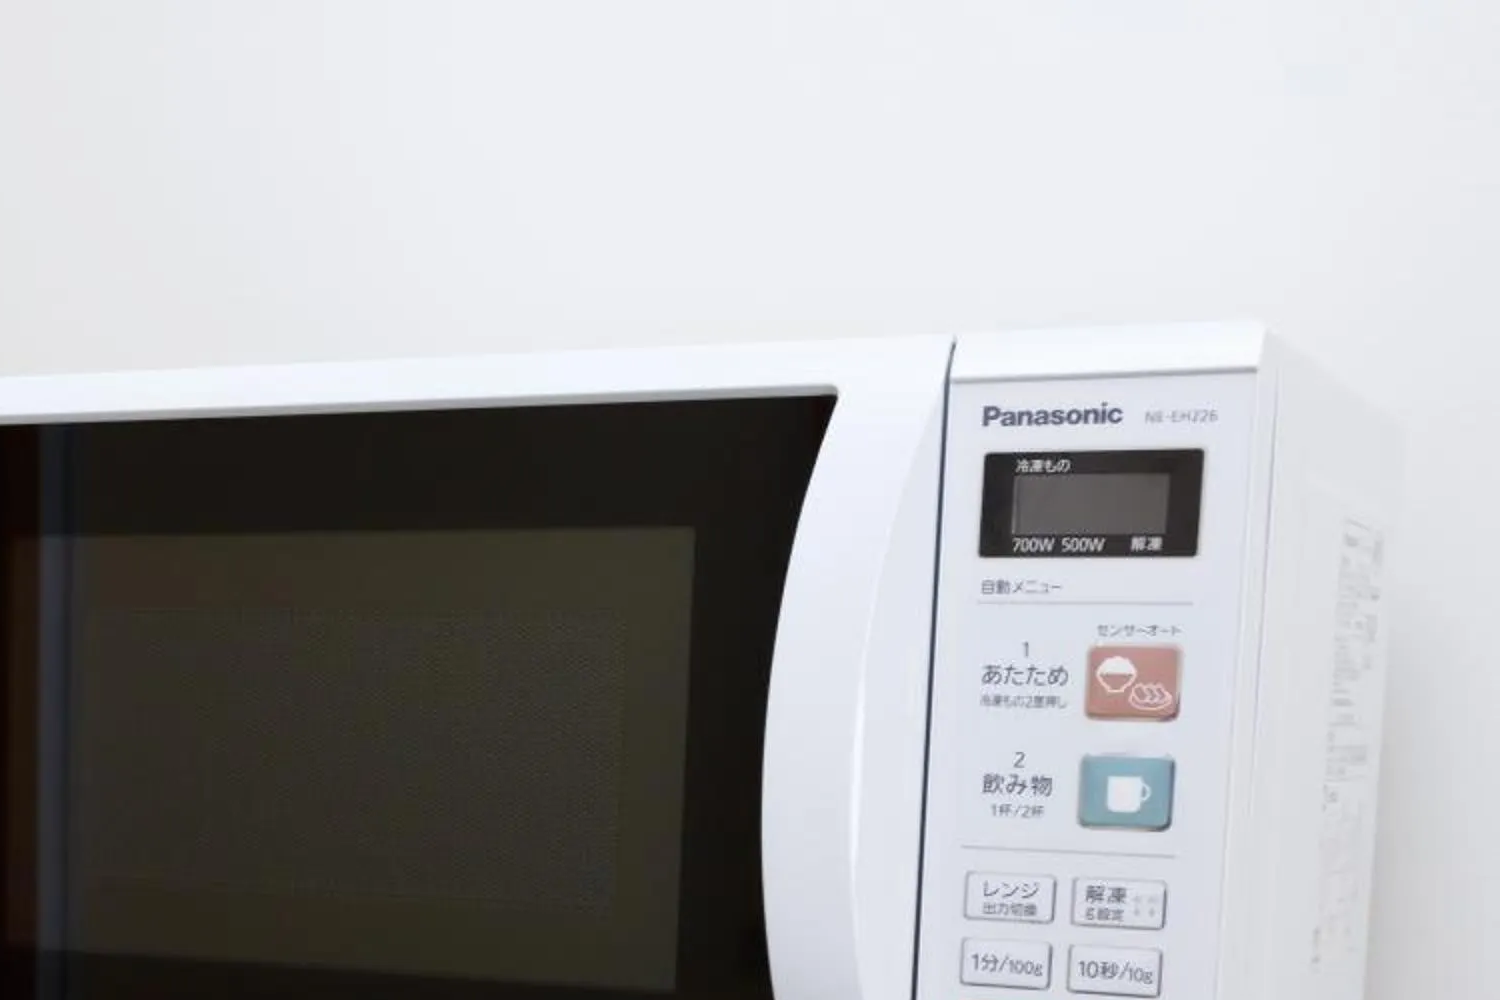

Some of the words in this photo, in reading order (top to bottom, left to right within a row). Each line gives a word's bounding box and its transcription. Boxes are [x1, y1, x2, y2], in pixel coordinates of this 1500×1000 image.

[982, 402, 1124, 427] Panasonic
[1015, 459, 1071, 473] 冷凍もの
[1012, 537, 1055, 552] 700W
[1061, 537, 1106, 552] 500W
[1131, 536, 1163, 551] 解凍
[981, 579, 1063, 595] 自動メニュー
[1022, 642, 1030, 657] 1
[981, 665, 1069, 687] あたため
[1013, 752, 1026, 768] 2
[982, 773, 1053, 797] 飲み物
[991, 804, 1044, 818] 1杯/2杯
[983, 880, 1040, 899] レンジ
[1085, 885, 1127, 904] 解凍
[971, 953, 1043, 977] 1分/100g
[1078, 959, 1153, 985] 10秒/10g
